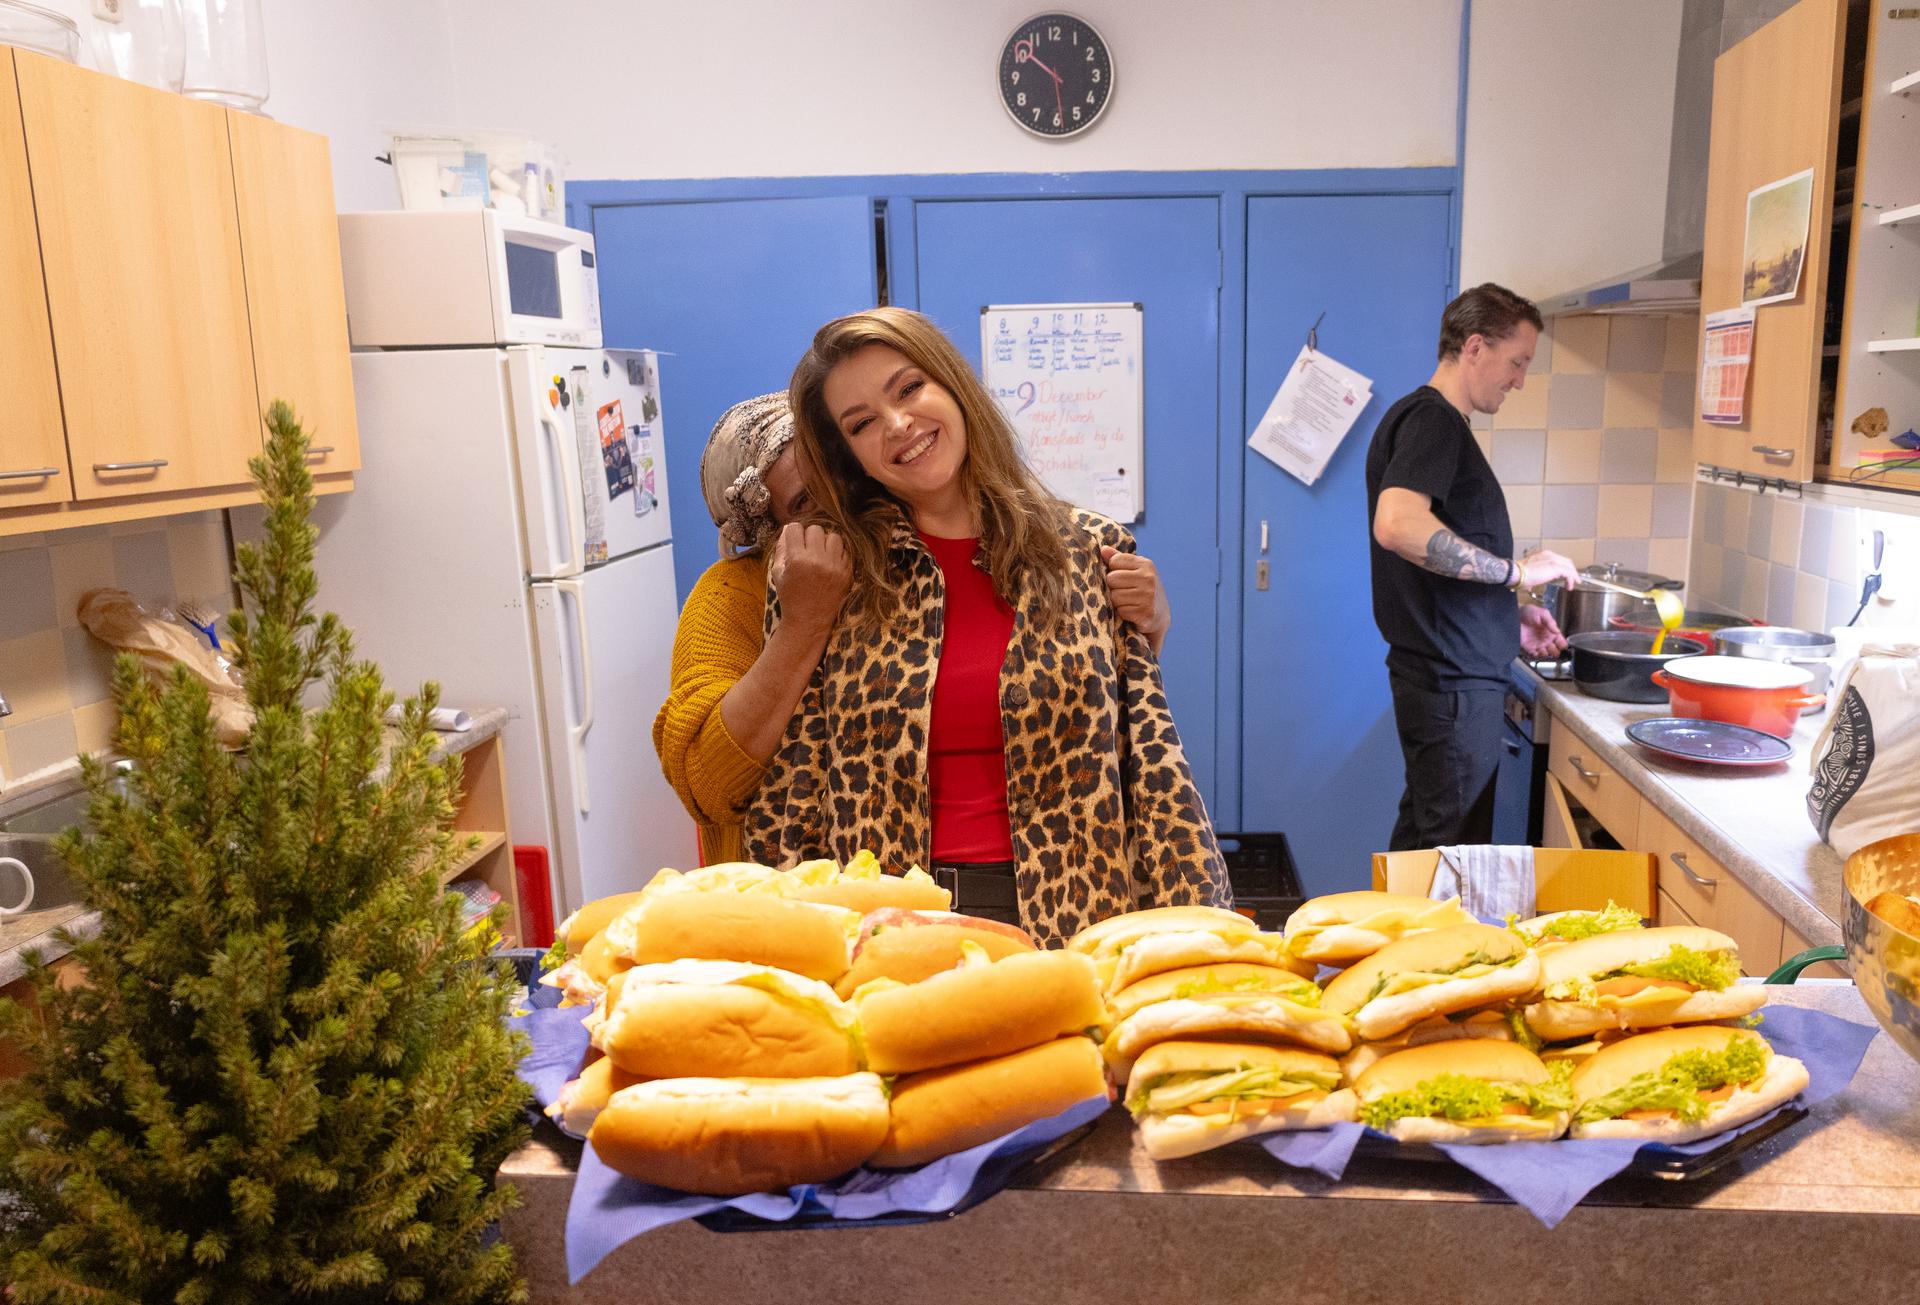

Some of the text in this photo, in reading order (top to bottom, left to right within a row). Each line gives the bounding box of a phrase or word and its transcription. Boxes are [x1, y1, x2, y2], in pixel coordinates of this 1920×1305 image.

[1029, 33, 1040, 47] 11
[1048, 26, 1061, 41] 12
[1073, 31, 1078, 46] 1
[1014, 49, 1028, 63] 10
[1086, 47, 1095, 61] 2
[1011, 71, 1020, 86] 9
[1091, 69, 1101, 83] 3
[1017, 92, 1027, 106] 8
[1086, 90, 1095, 105] 4
[1032, 107, 1041, 122] 7
[1052, 112, 1061, 127] 6
[1072, 106, 1081, 121] 5
[1000, 313, 1108, 330] 8 9 10 11 12
[1015, 380, 1107, 417] 9 December
[1856, 734, 1868, 765] SINDS
[1841, 768, 1862, 793] 1895
